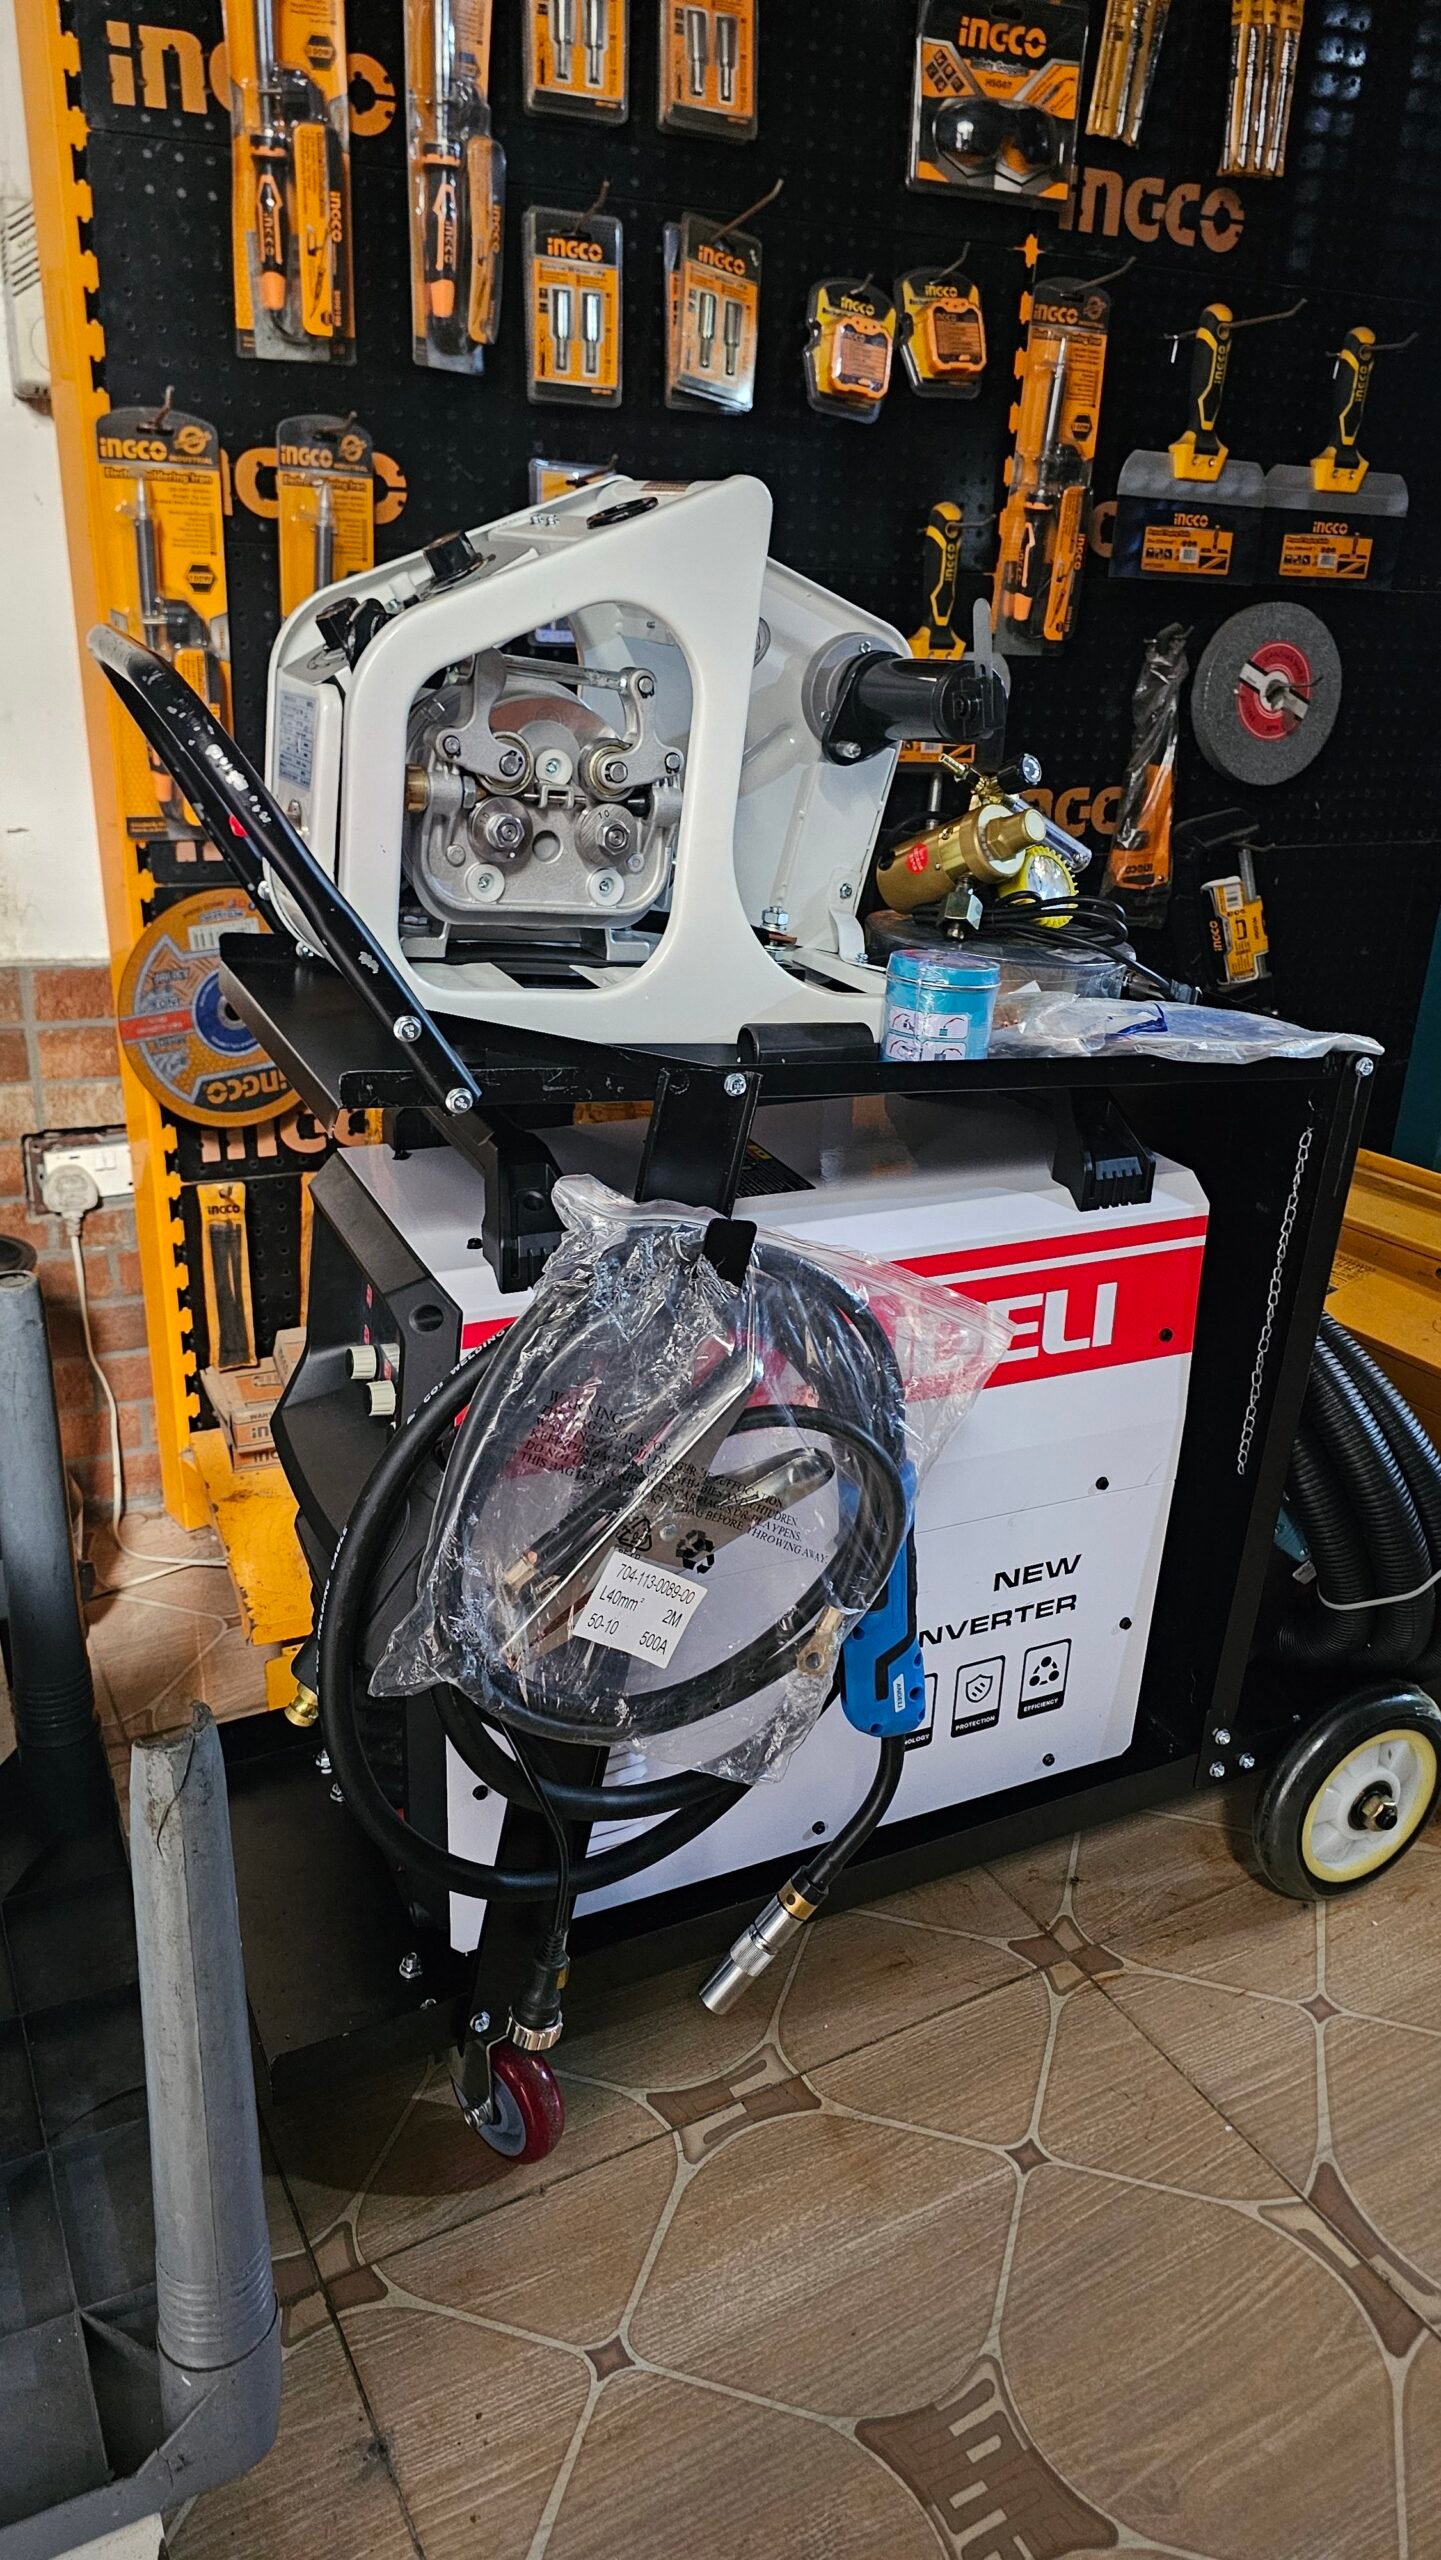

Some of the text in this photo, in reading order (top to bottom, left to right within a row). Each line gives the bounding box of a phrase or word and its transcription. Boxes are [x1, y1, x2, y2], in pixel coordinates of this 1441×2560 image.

[959, 16, 1046, 58] iNGCO
[330, 191, 342, 243] iNGCO
[547, 237, 603, 262] iNGCO
[698, 245, 746, 276] iNGCO
[924, 284, 957, 298] iNGCO
[841, 296, 875, 316] iNGCO
[1033, 304, 1079, 325] iNGCO
[1214, 345, 1226, 384] iNGCO
[1355, 365, 1368, 402] iNGCO
[99, 438, 168, 462] iNGCO
[281, 445, 333, 468] iNGCO
[146, 470, 190, 485] oldering
[1174, 513, 1208, 527] iNGCO
[1313, 521, 1348, 535] iNGCO
[945, 542, 956, 581] iNGCO
[1209, 920, 1224, 952] iNGCO
[207, 1205, 240, 1215] iNGCO
[985, 1282, 1118, 1364] ELI
[450, 1330, 505, 1375] WELDING
[616, 1564, 696, 1605] 704-113-0089-00
[993, 1554, 1082, 1591] NEW
[661, 1608, 683, 1627] 2M
[918, 1594, 1077, 1648] NVERTER
[586, 1612, 670, 1653] 50-10 500A
[1023, 1697, 1059, 1712] EFFICIENCY
[955, 1715, 996, 1731] PROTECTION
